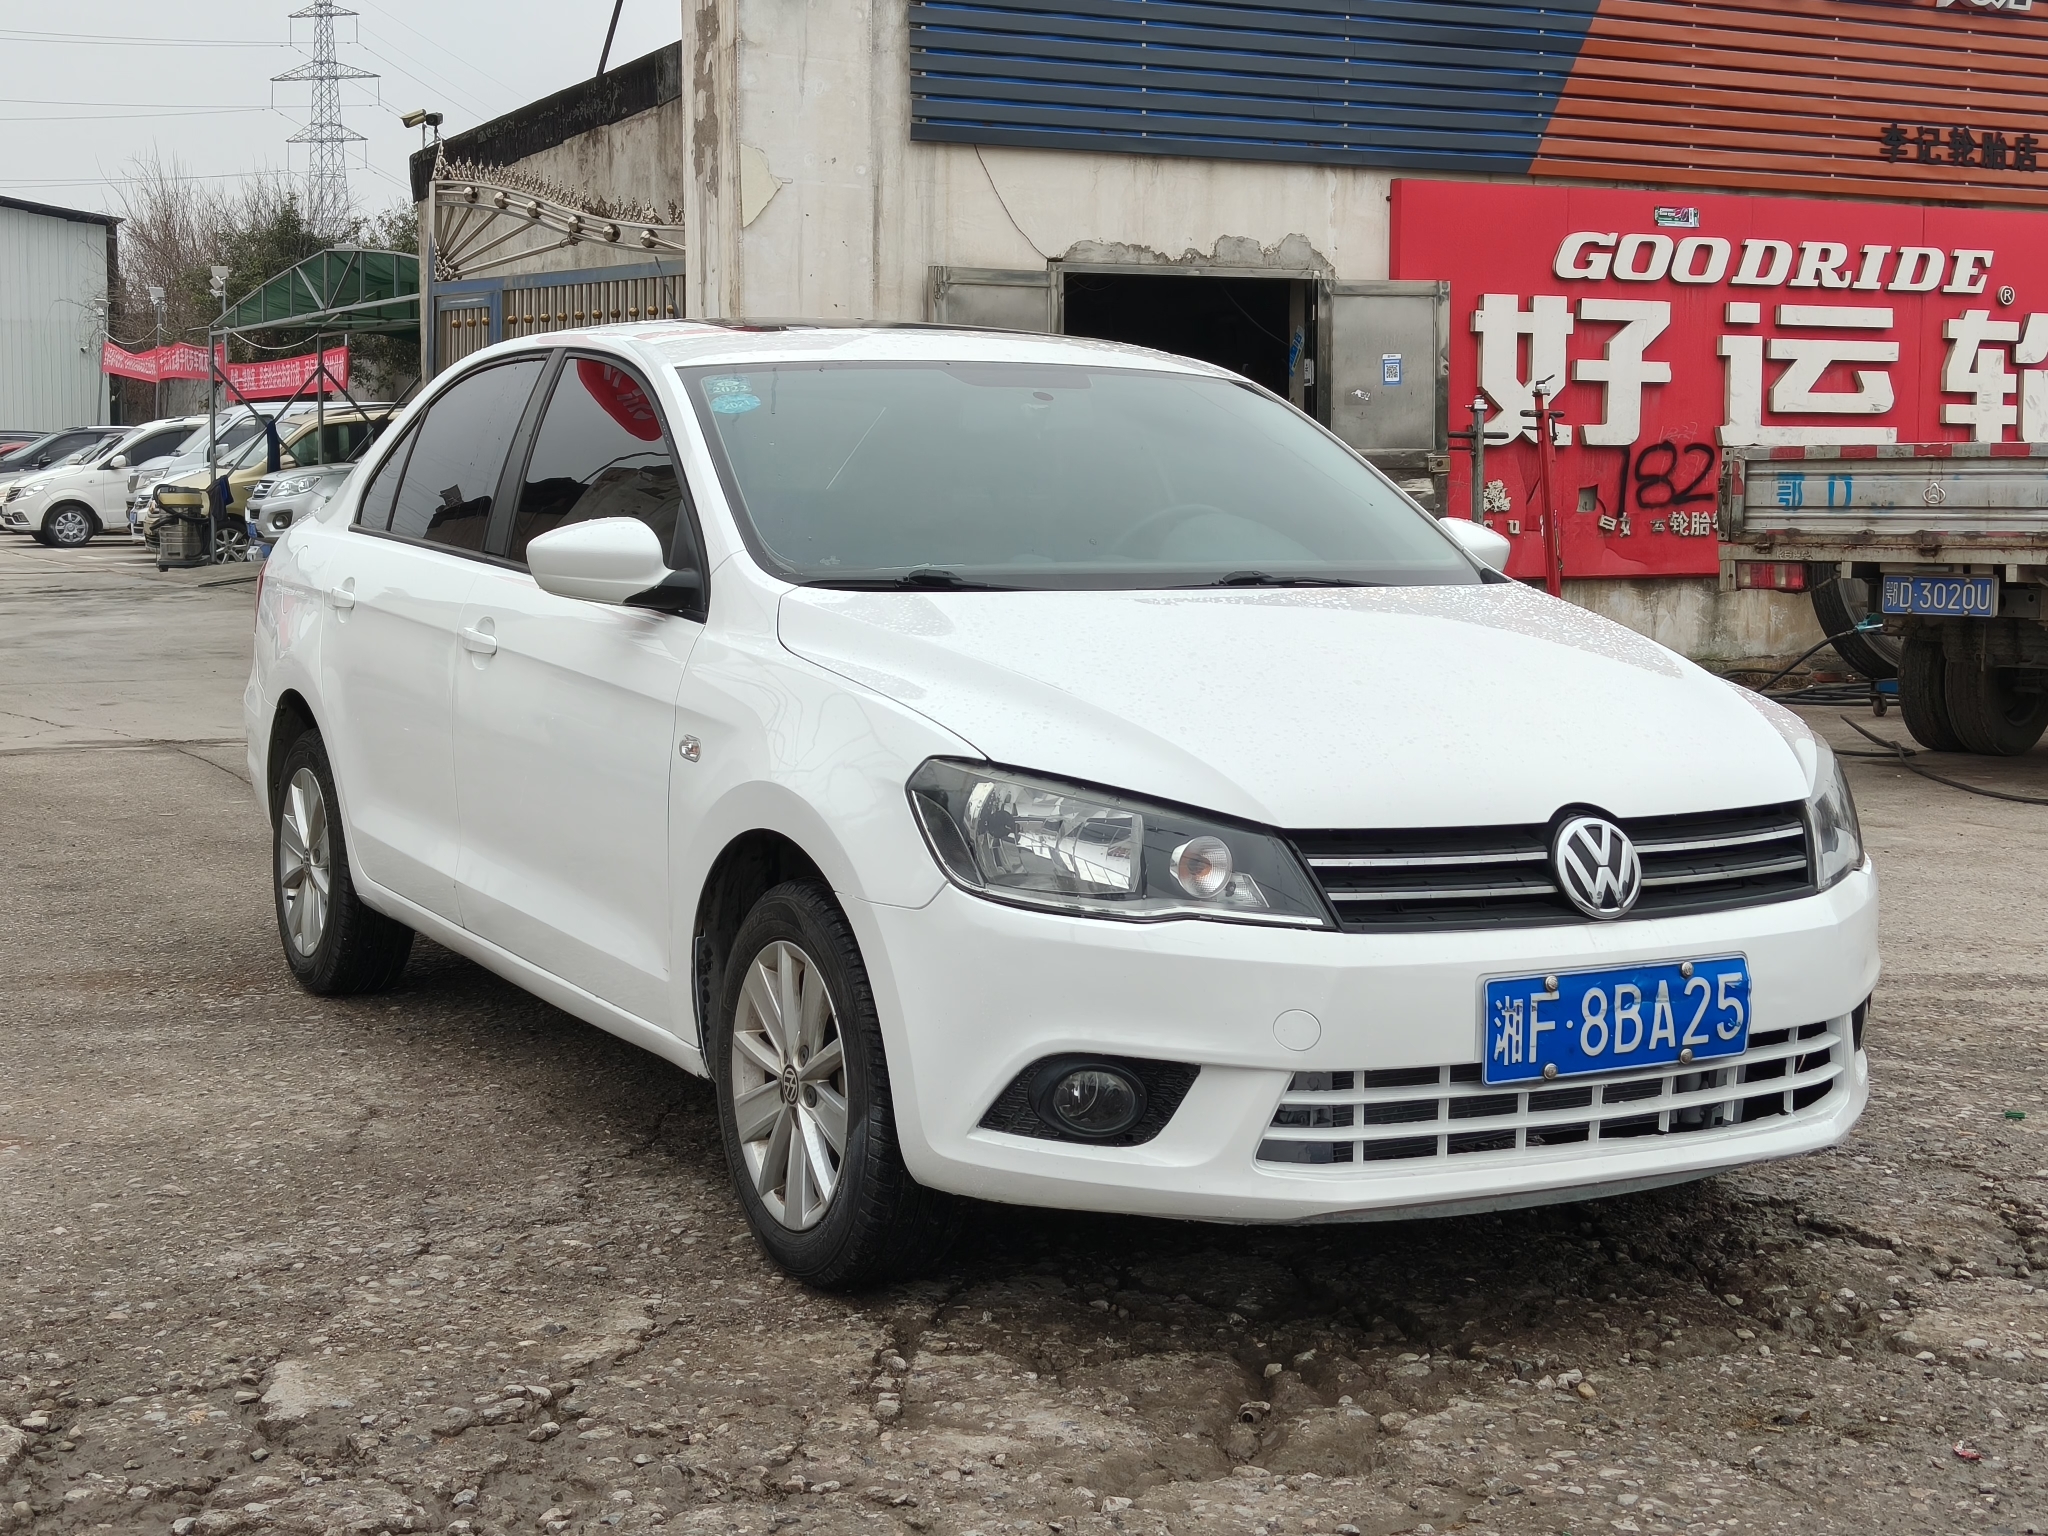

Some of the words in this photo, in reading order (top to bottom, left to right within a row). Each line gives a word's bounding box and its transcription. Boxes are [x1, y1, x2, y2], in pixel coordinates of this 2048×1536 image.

[1879, 123, 2039, 172] 李记轮胎店
[1552, 231, 1994, 295] GOODRIDE
[1885, 580, 1991, 611] 鄂D·3020U
[1494, 971, 1745, 1066] 湘F·8BA25
